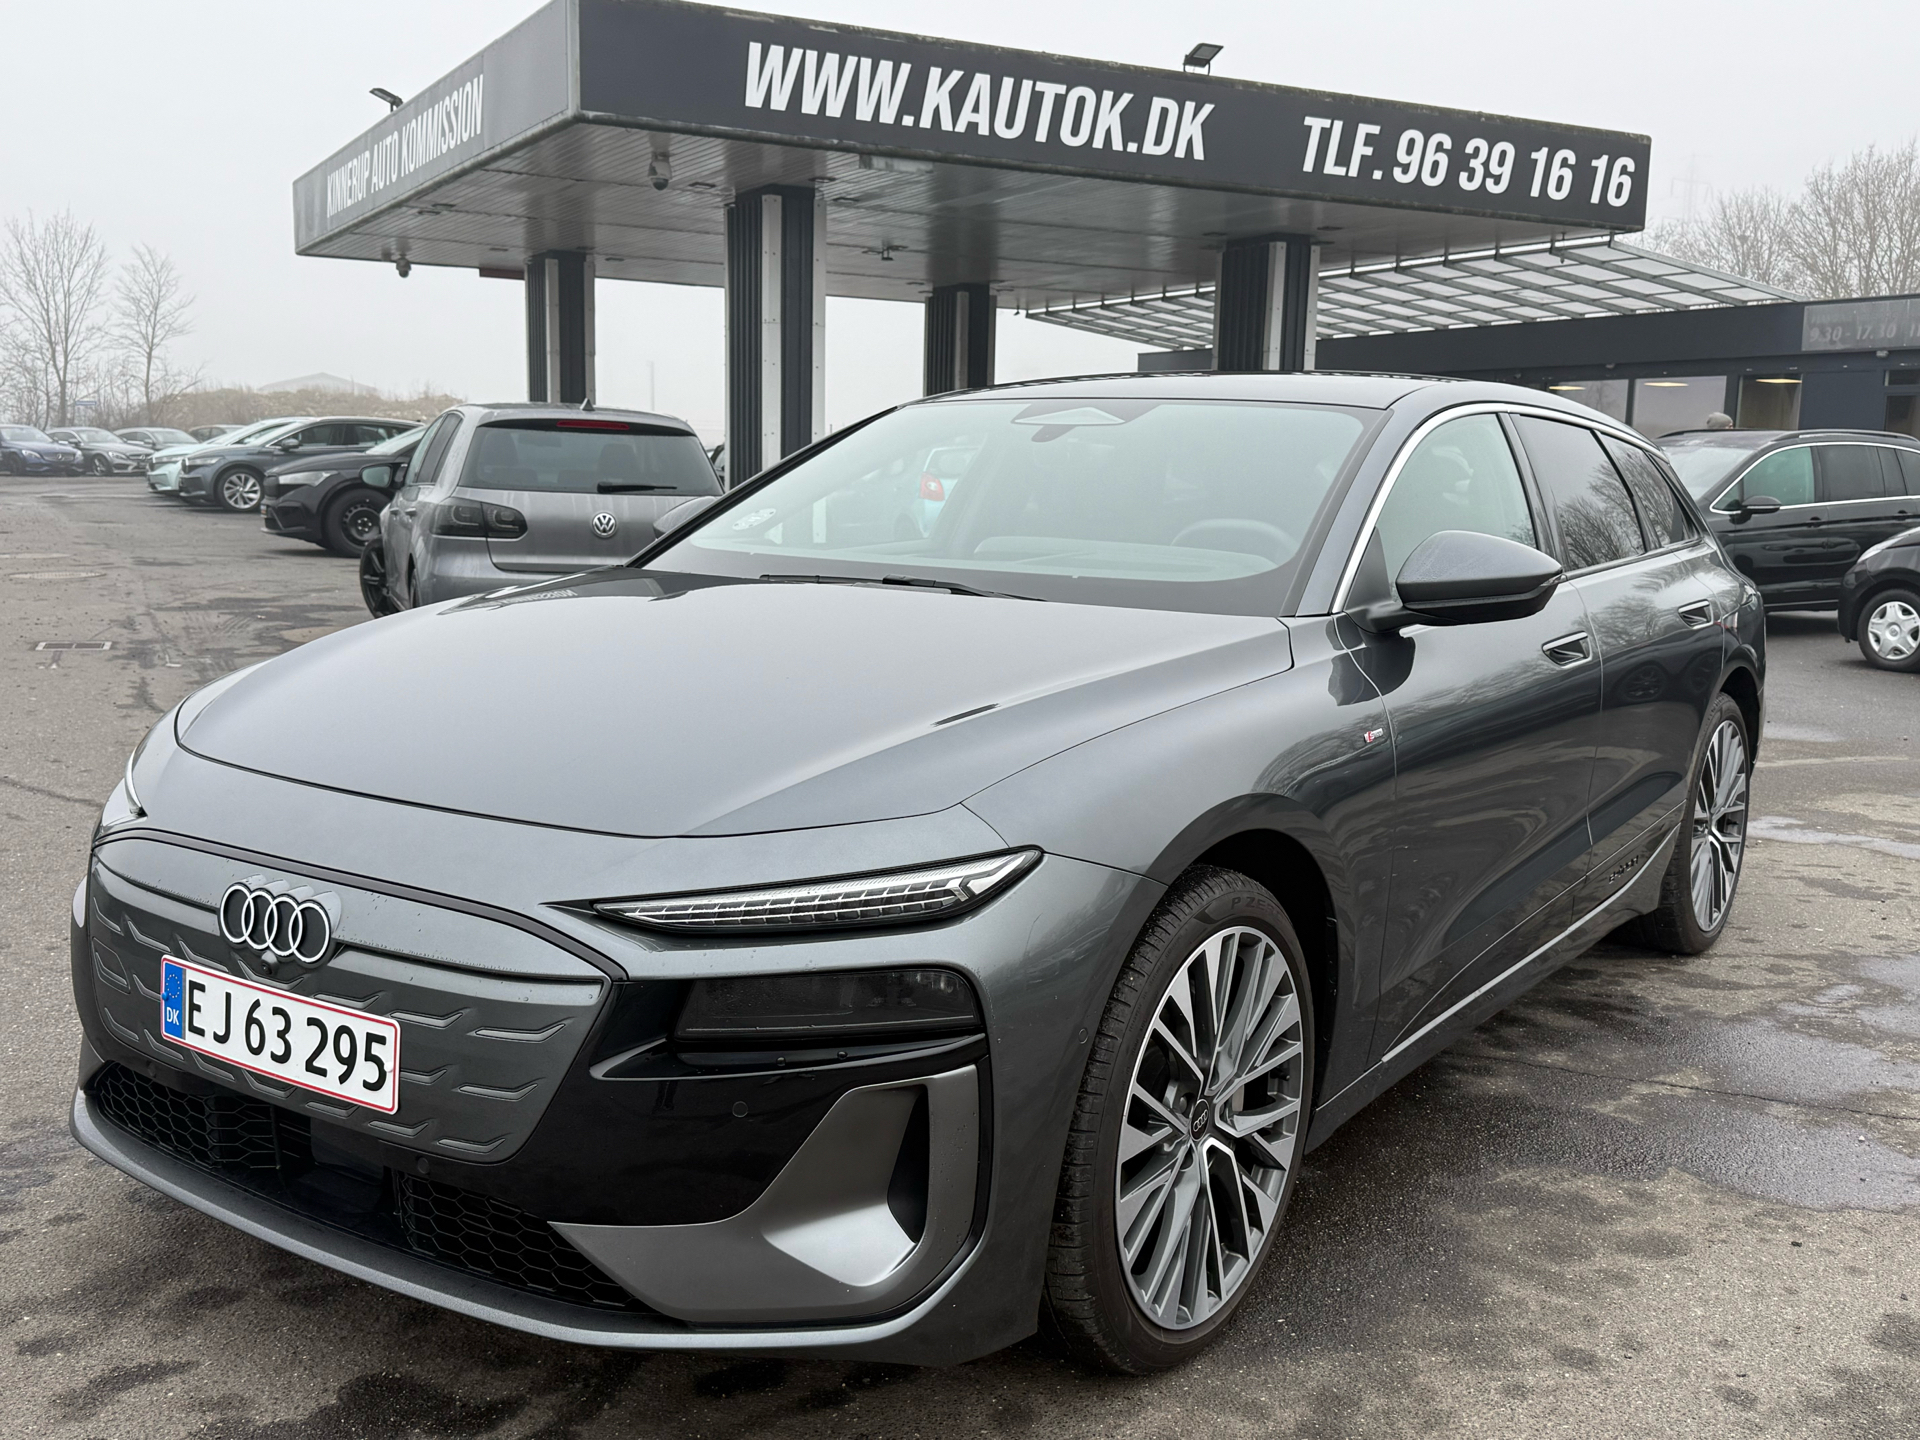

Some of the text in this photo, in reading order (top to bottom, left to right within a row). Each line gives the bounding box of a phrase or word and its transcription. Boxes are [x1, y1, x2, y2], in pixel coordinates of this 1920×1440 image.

[327, 73, 484, 219] KINNERUP AUTO KOMMISSION
[744, 41, 1215, 161] WWW.KAUTOK.DK
[1302, 116, 1635, 208] TLF. 96 39 16 16
[166, 1006, 180, 1025] DK
[188, 979, 388, 1092] EJ 63 295
